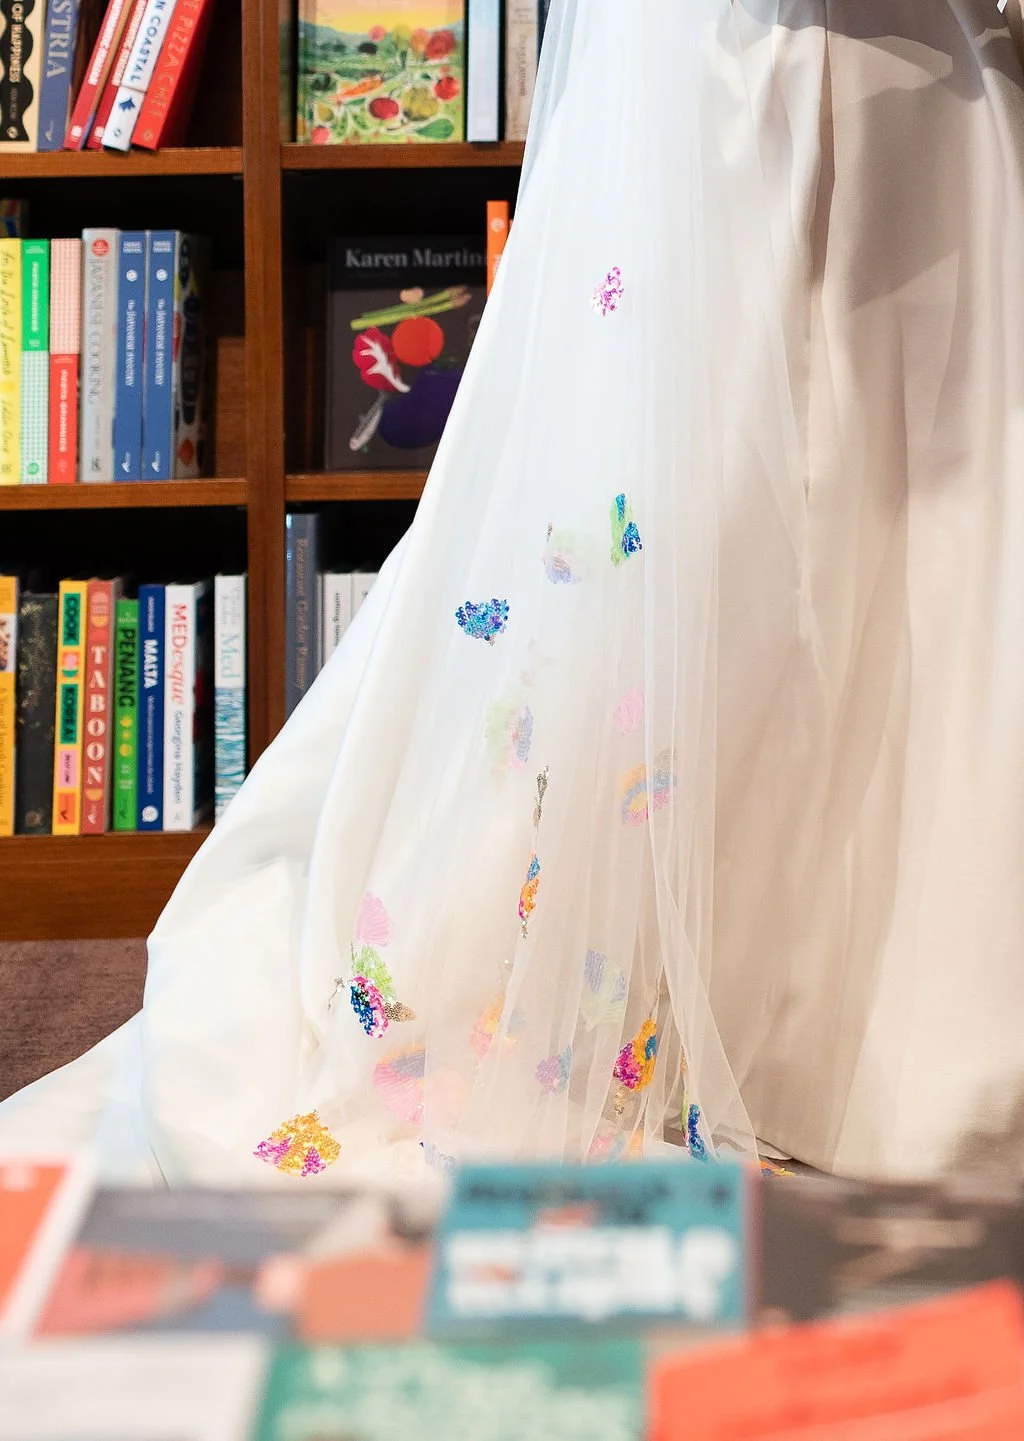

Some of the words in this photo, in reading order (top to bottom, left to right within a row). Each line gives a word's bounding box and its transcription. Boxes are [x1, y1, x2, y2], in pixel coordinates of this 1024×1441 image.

[12, 4, 25, 22] OF
[9, 24, 23, 83] HAPPINESS
[130, 15, 161, 83] COASTAL
[165, 15, 194, 68] PIZZA
[149, 71, 177, 119] CHEF
[345, 249, 408, 268] Karen
[87, 261, 103, 326] JAPANESE
[87, 331, 103, 405] COOKING
[64, 597, 79, 642] COOK
[118, 627, 136, 708] PENANG
[144, 639, 158, 689] MALTA
[166, 603, 189, 705] MEDesque
[221, 632, 240, 679] Med
[86, 646, 106, 784] TABOON
[171, 710, 184, 760] Georgina
[172, 763, 185, 805] Hayden
